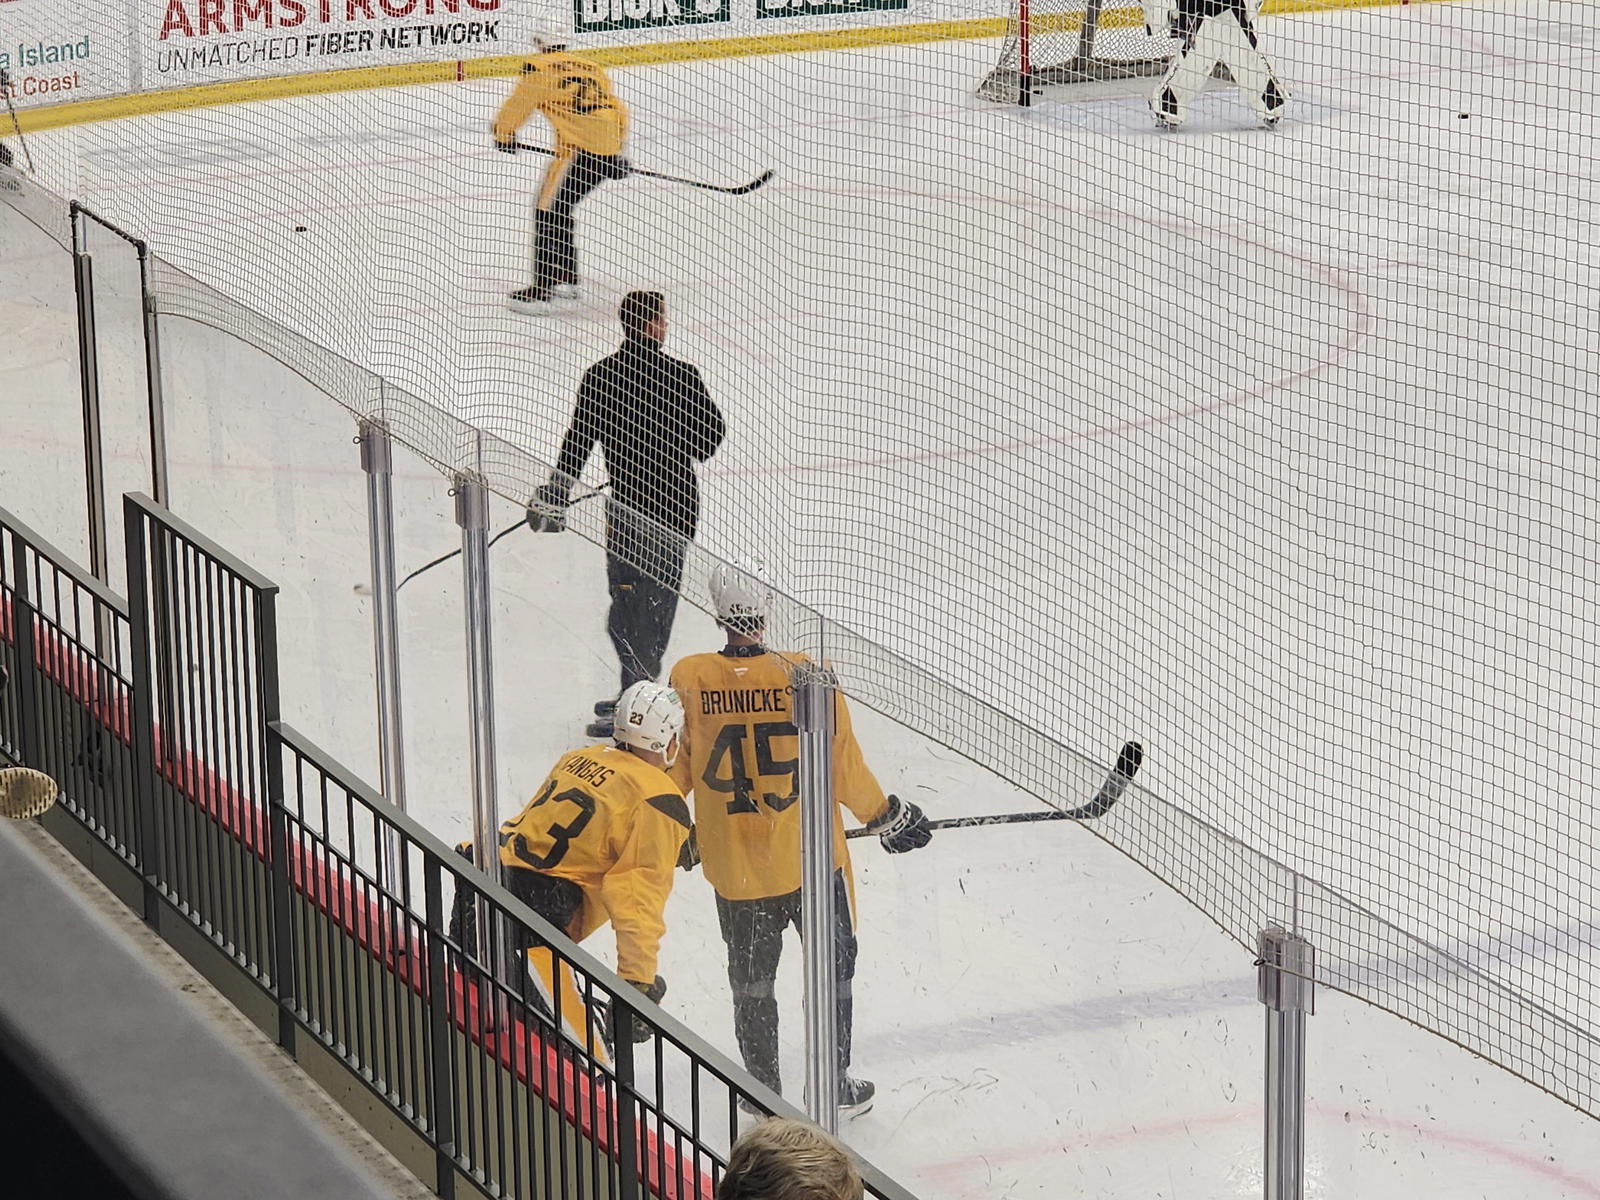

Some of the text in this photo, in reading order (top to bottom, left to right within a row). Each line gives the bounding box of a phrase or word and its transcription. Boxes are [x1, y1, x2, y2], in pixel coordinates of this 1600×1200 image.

[159, 0, 502, 41] ARMSTR
[19, 35, 89, 67] Island
[158, 20, 501, 73] UNMATCHED FIBER NETWORK
[23, 71, 81, 96] Coast
[700, 688, 786, 715] BRUNICKE
[629, 711, 644, 726] 23
[702, 721, 800, 815] 45
